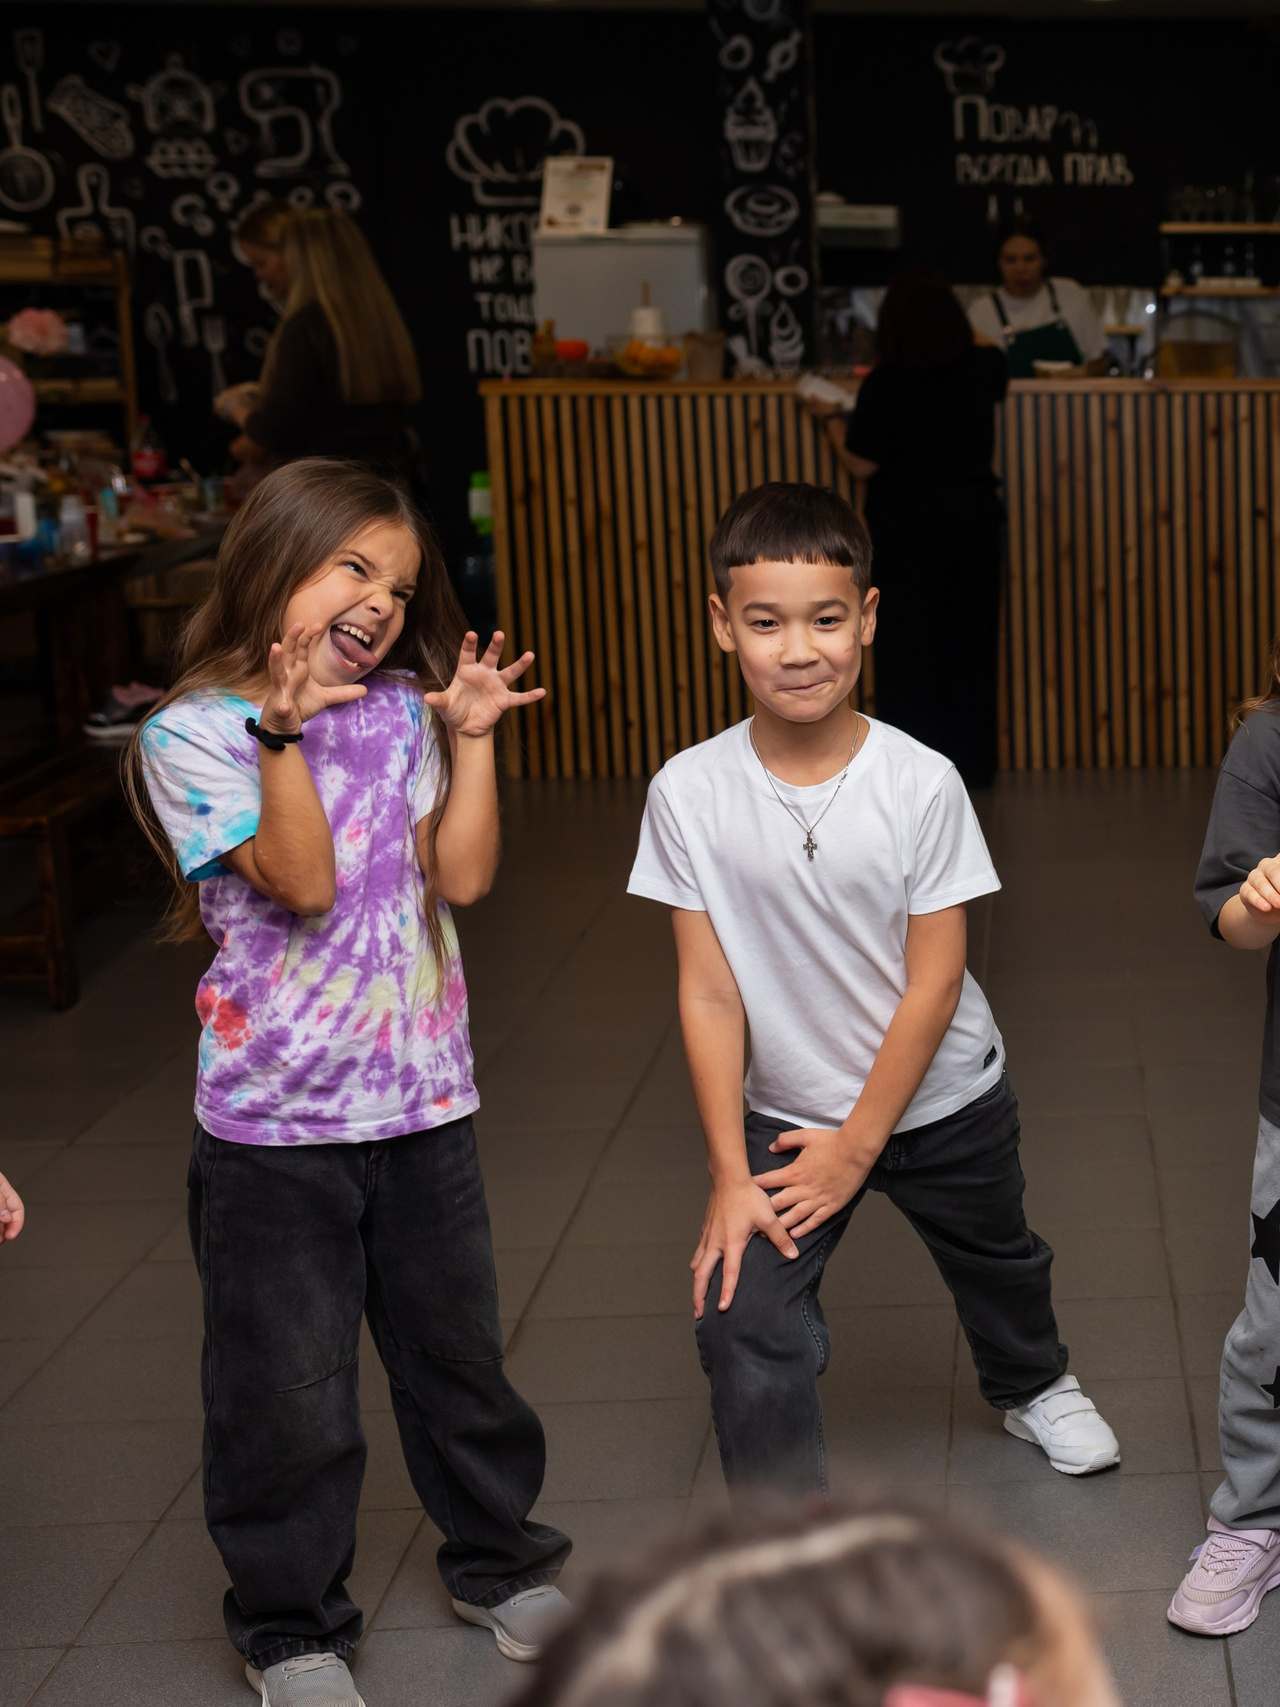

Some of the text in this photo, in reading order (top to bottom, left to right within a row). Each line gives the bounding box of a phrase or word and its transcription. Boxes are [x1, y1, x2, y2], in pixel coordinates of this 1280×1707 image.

[1063, 152, 1134, 186] ПРАВ
[450, 213, 540, 251] НИКО
[466, 328, 532, 374] ПОВ
